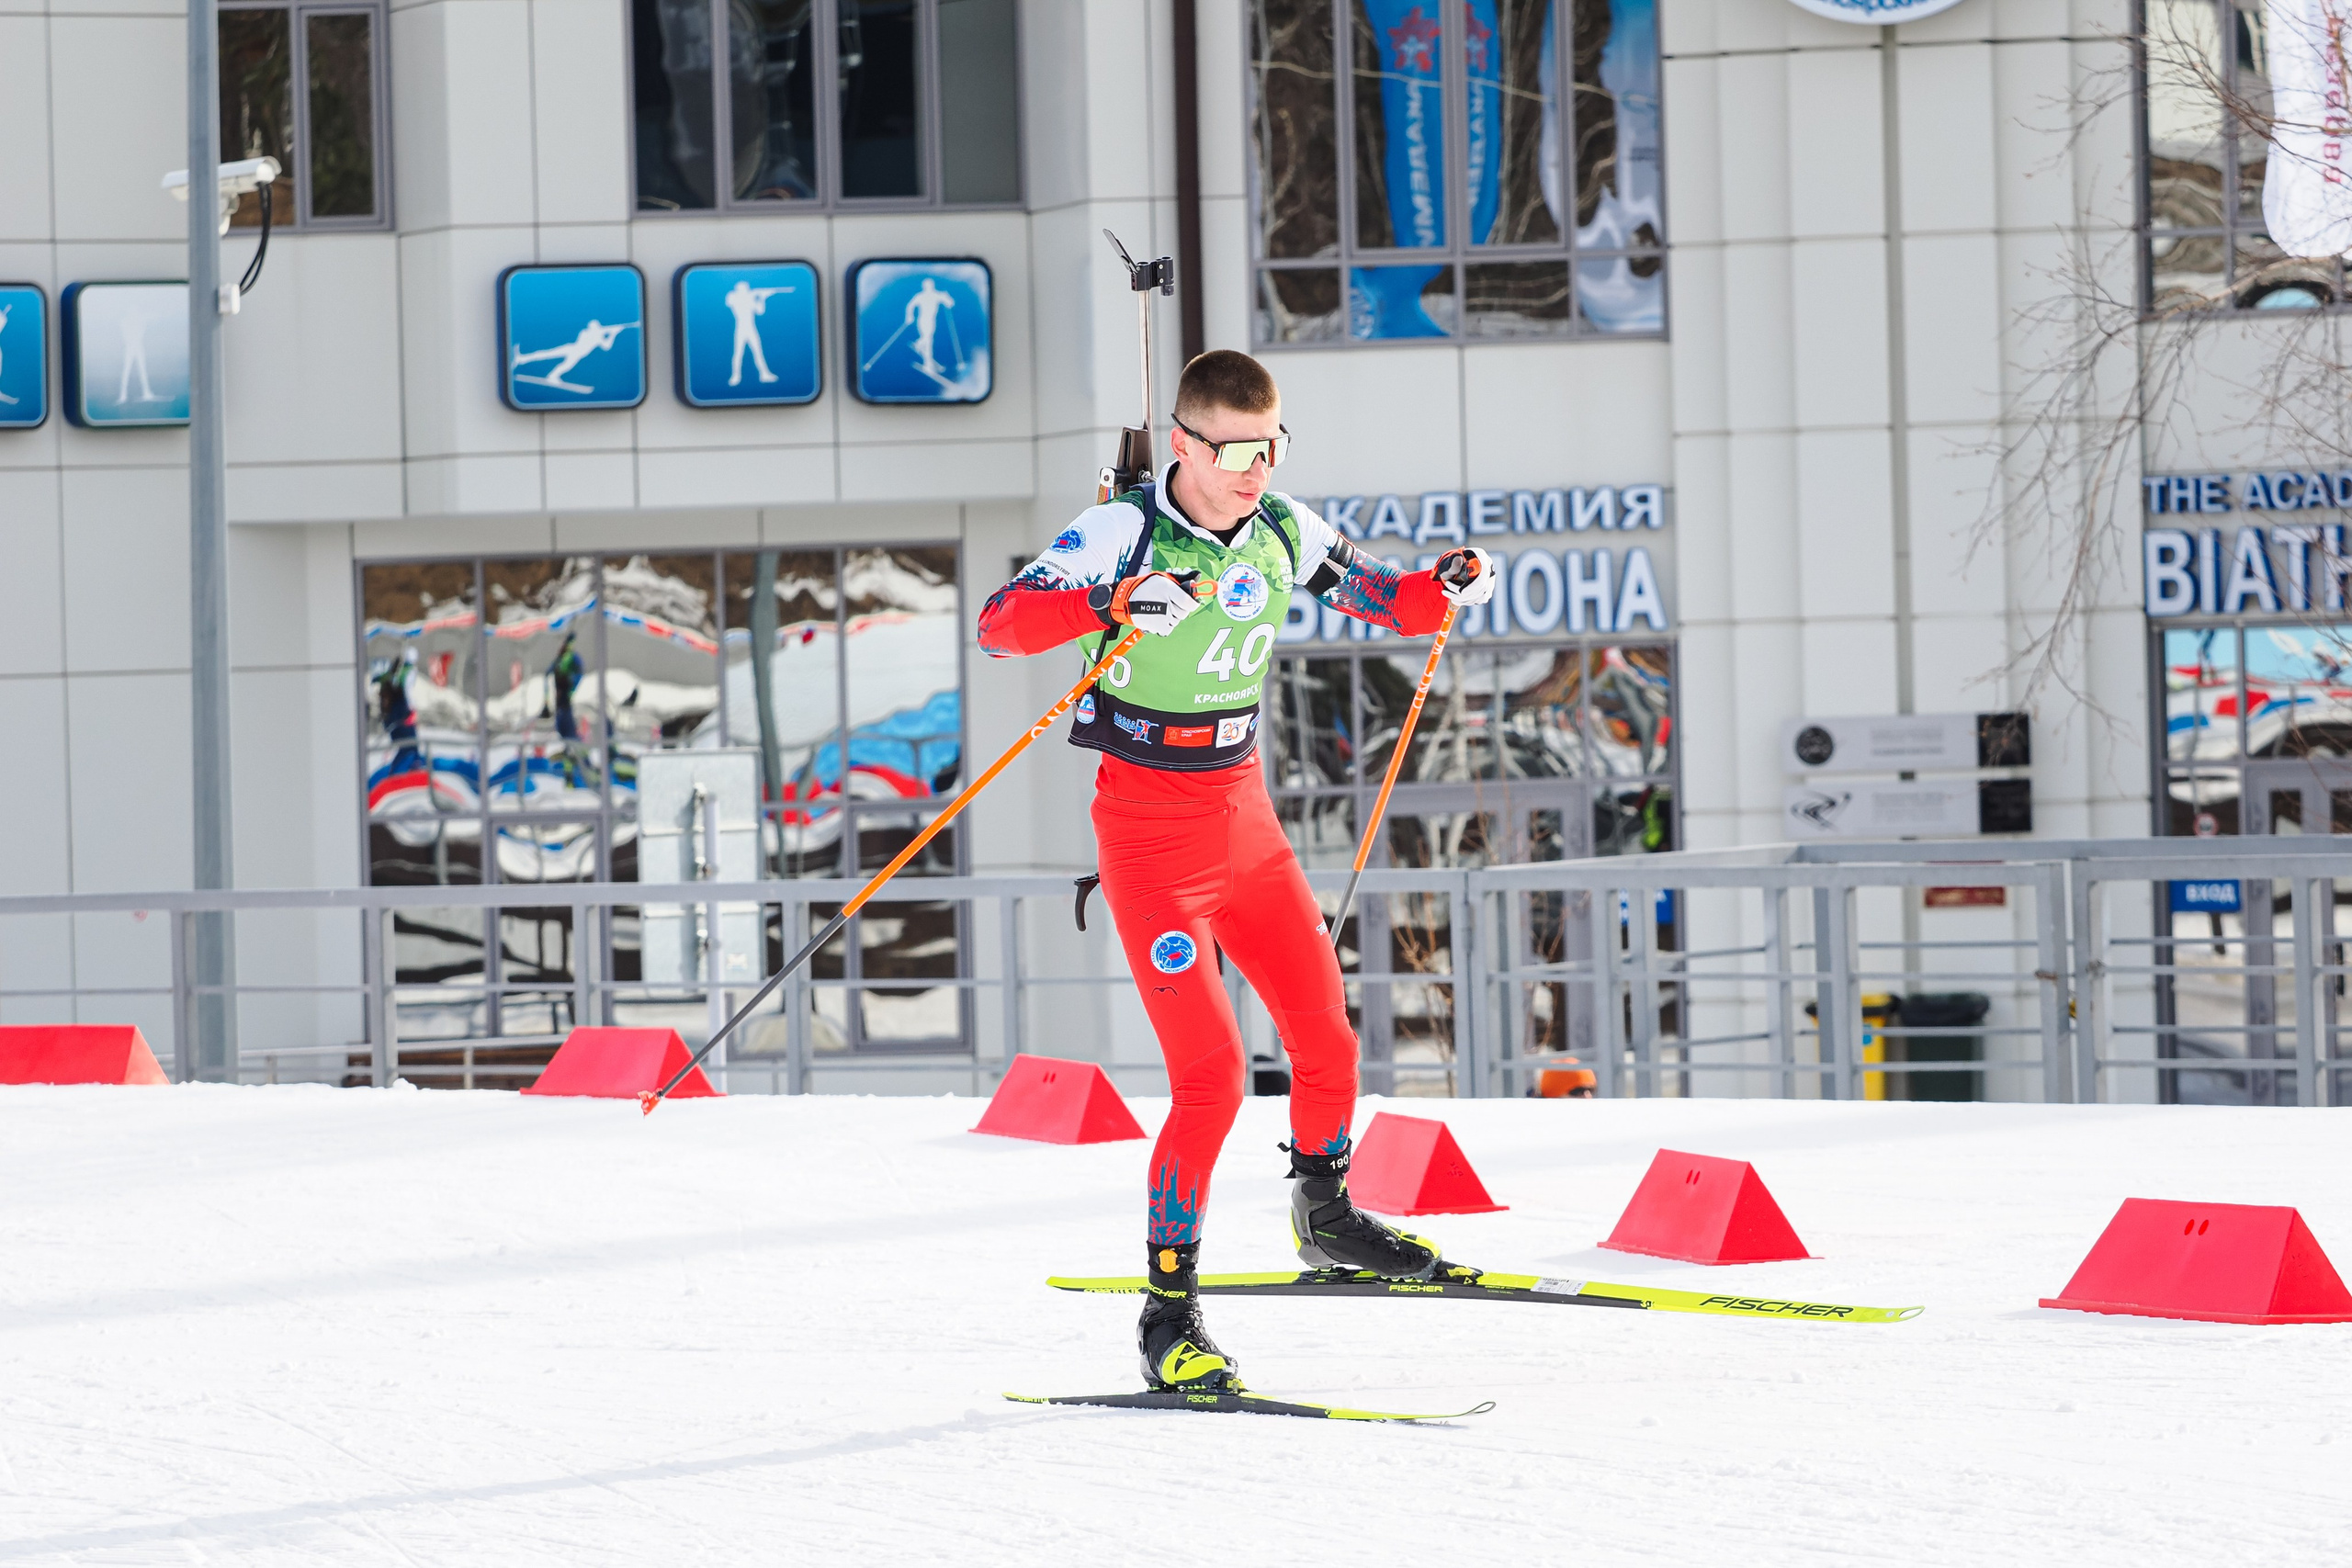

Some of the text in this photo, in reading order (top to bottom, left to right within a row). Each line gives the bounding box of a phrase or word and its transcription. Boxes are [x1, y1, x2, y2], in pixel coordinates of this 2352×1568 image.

[2143, 474, 2231, 513] THE
[1294, 483, 1666, 547] КАДЕМИЯ
[1195, 623, 1277, 682] 40
[1194, 682, 1260, 705] КРАСНОЯРСК
[2185, 882, 2236, 904] ВХОД
[1388, 1284, 1443, 1293] FISCHER
[1699, 1295, 1854, 1319] FISCHER
[1186, 1394, 1218, 1404] FISCHER
